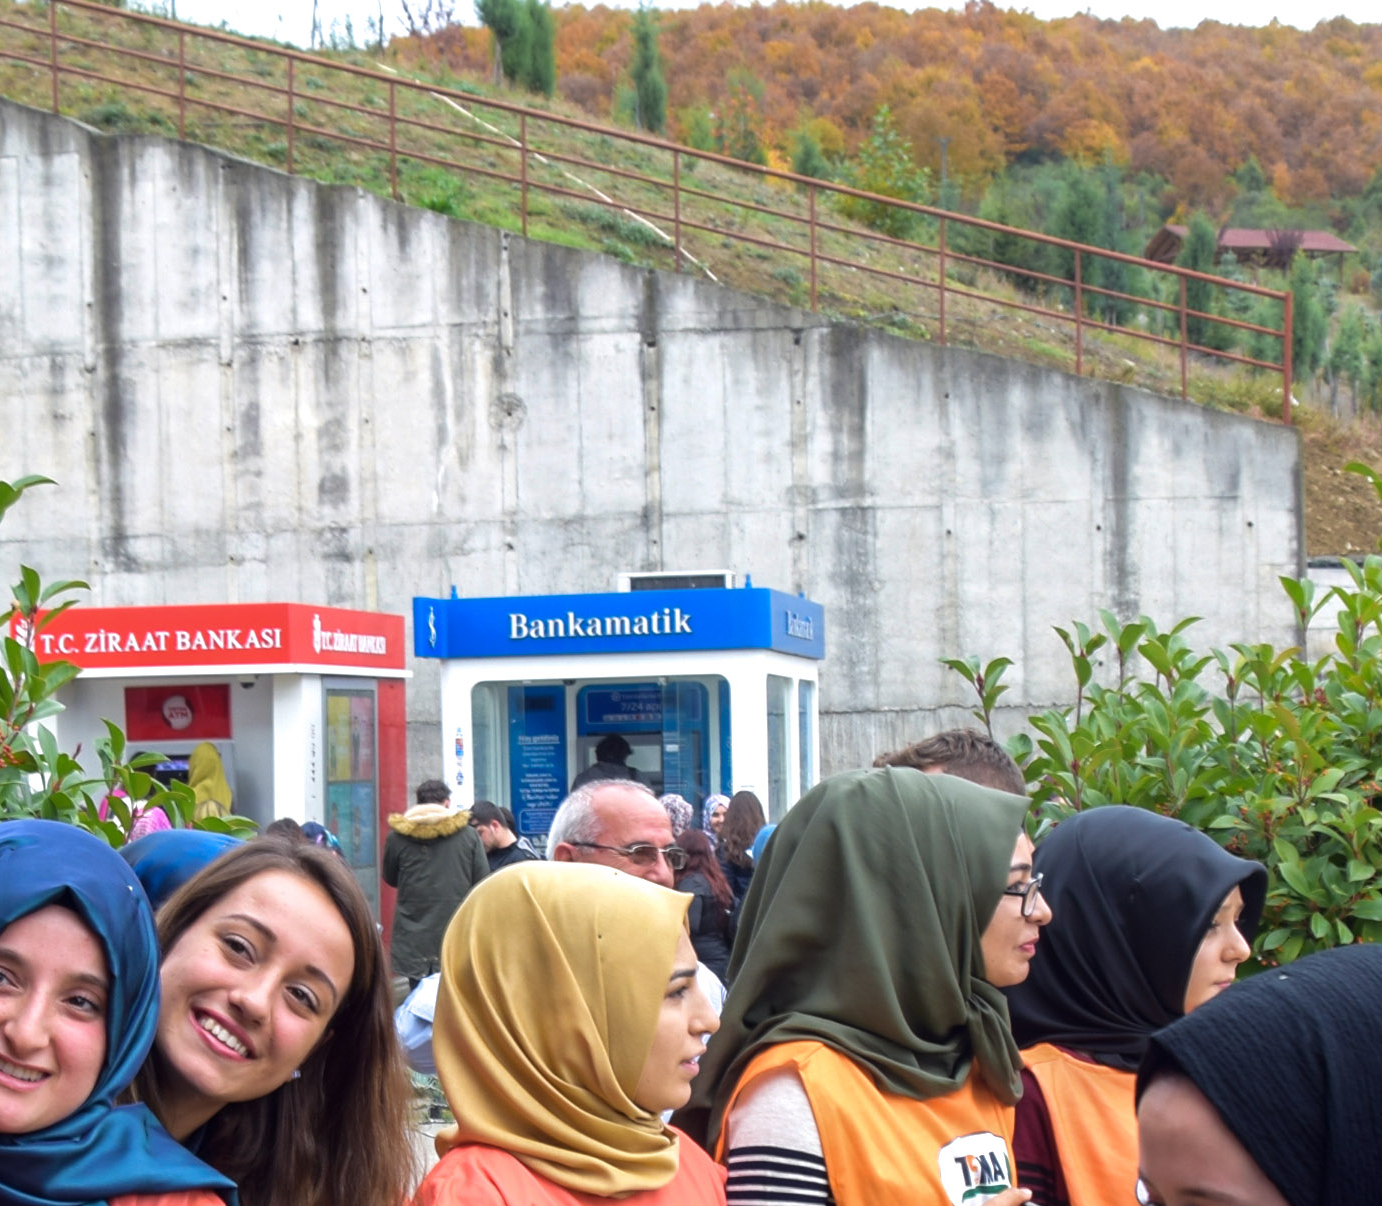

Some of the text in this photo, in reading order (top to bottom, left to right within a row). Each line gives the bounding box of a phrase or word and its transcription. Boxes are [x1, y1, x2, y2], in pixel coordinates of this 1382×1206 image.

[508, 608, 693, 640] Bankamatik
[40, 628, 282, 654] T.C. ZİRAAT BANKASI
